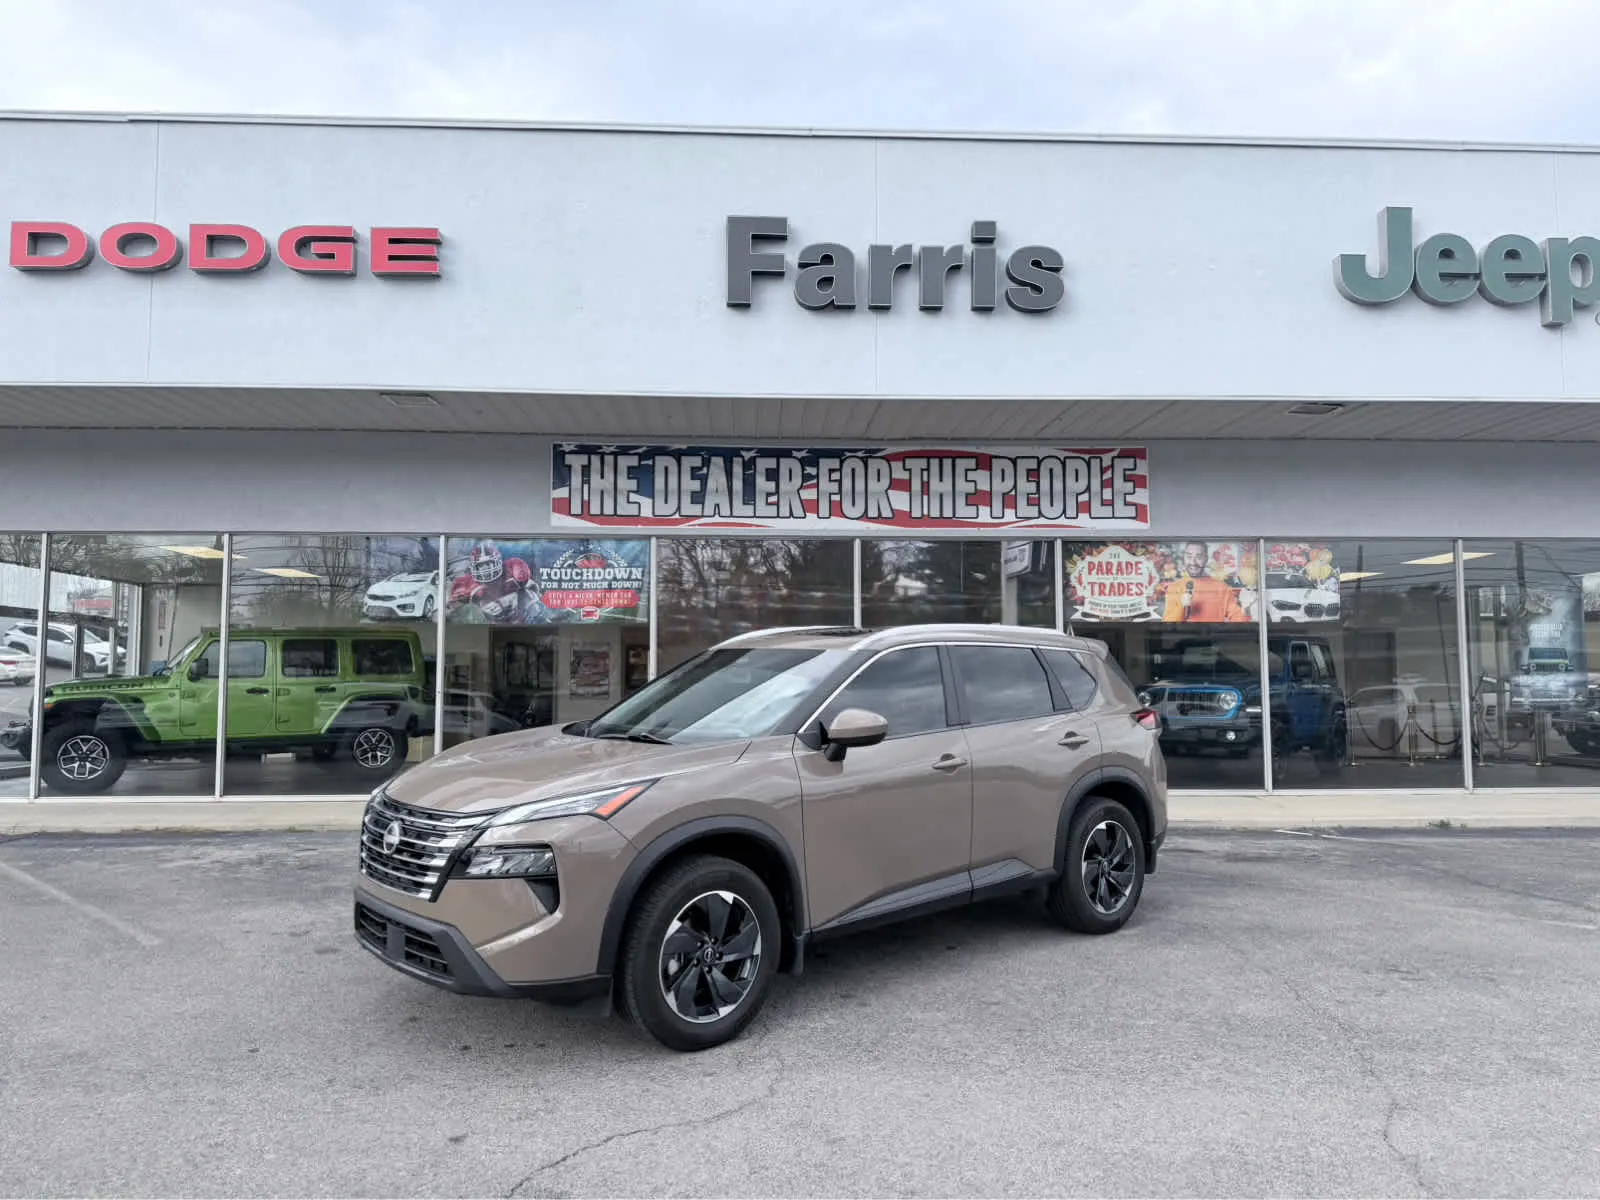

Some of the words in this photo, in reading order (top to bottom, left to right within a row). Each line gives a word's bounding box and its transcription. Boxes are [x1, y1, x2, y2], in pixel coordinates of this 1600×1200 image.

[9, 221, 442, 276] DODGE
[726, 216, 1065, 312] Farris
[1332, 206, 1600, 327] Jeep
[564, 453, 641, 517] THE
[646, 454, 807, 519] DEALER
[816, 455, 894, 520] FOR
[903, 456, 980, 520] THE
[989, 456, 1138, 519] PEOPLE
[540, 567, 643, 580] TOUCHDOWN
[541, 581, 558, 589] FOR
[561, 581, 579, 589] NOT
[583, 581, 608, 589] MUCH
[1087, 561, 1143, 576] PARADE
[1087, 581, 1145, 597] TRADES
